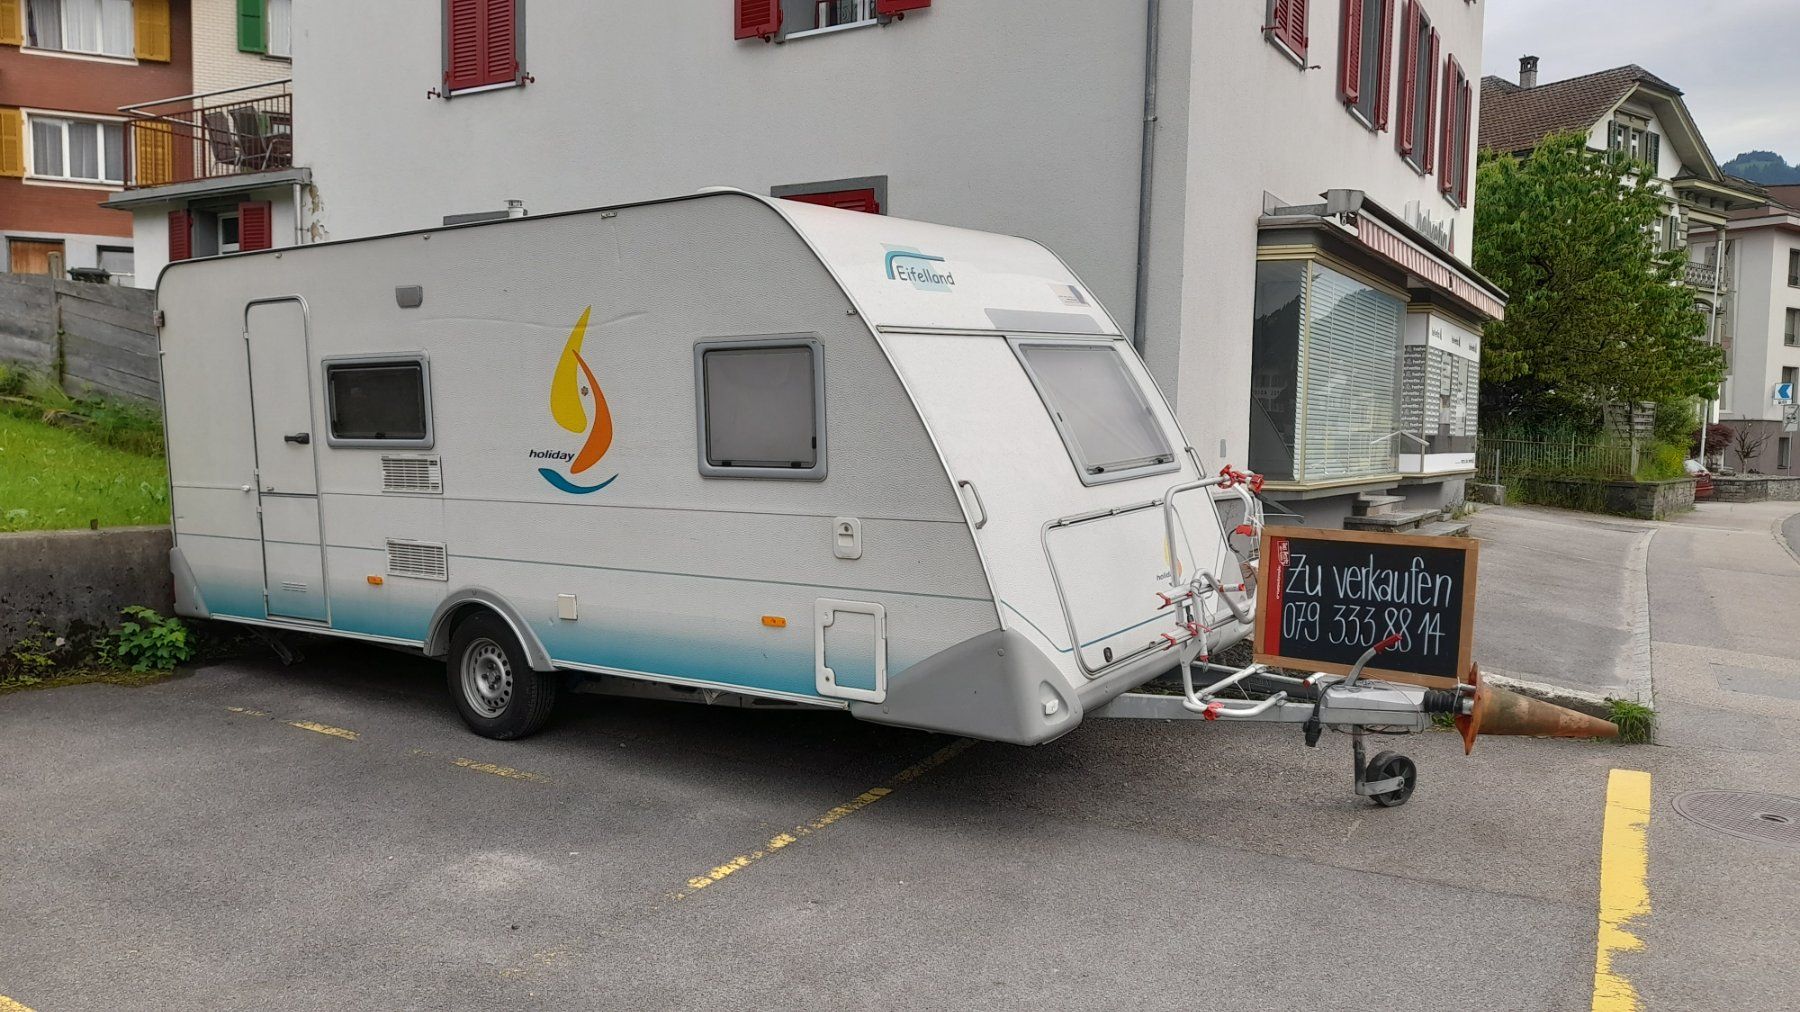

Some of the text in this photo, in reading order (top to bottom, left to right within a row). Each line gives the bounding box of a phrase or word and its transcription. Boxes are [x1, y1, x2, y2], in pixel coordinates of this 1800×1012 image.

[896, 265, 955, 286] Eifelland
[528, 449, 575, 463] holiday
[1285, 553, 1322, 597] Zu
[1332, 553, 1453, 608] verkaufen
[1283, 602, 1447, 656] 079 333 88 14
